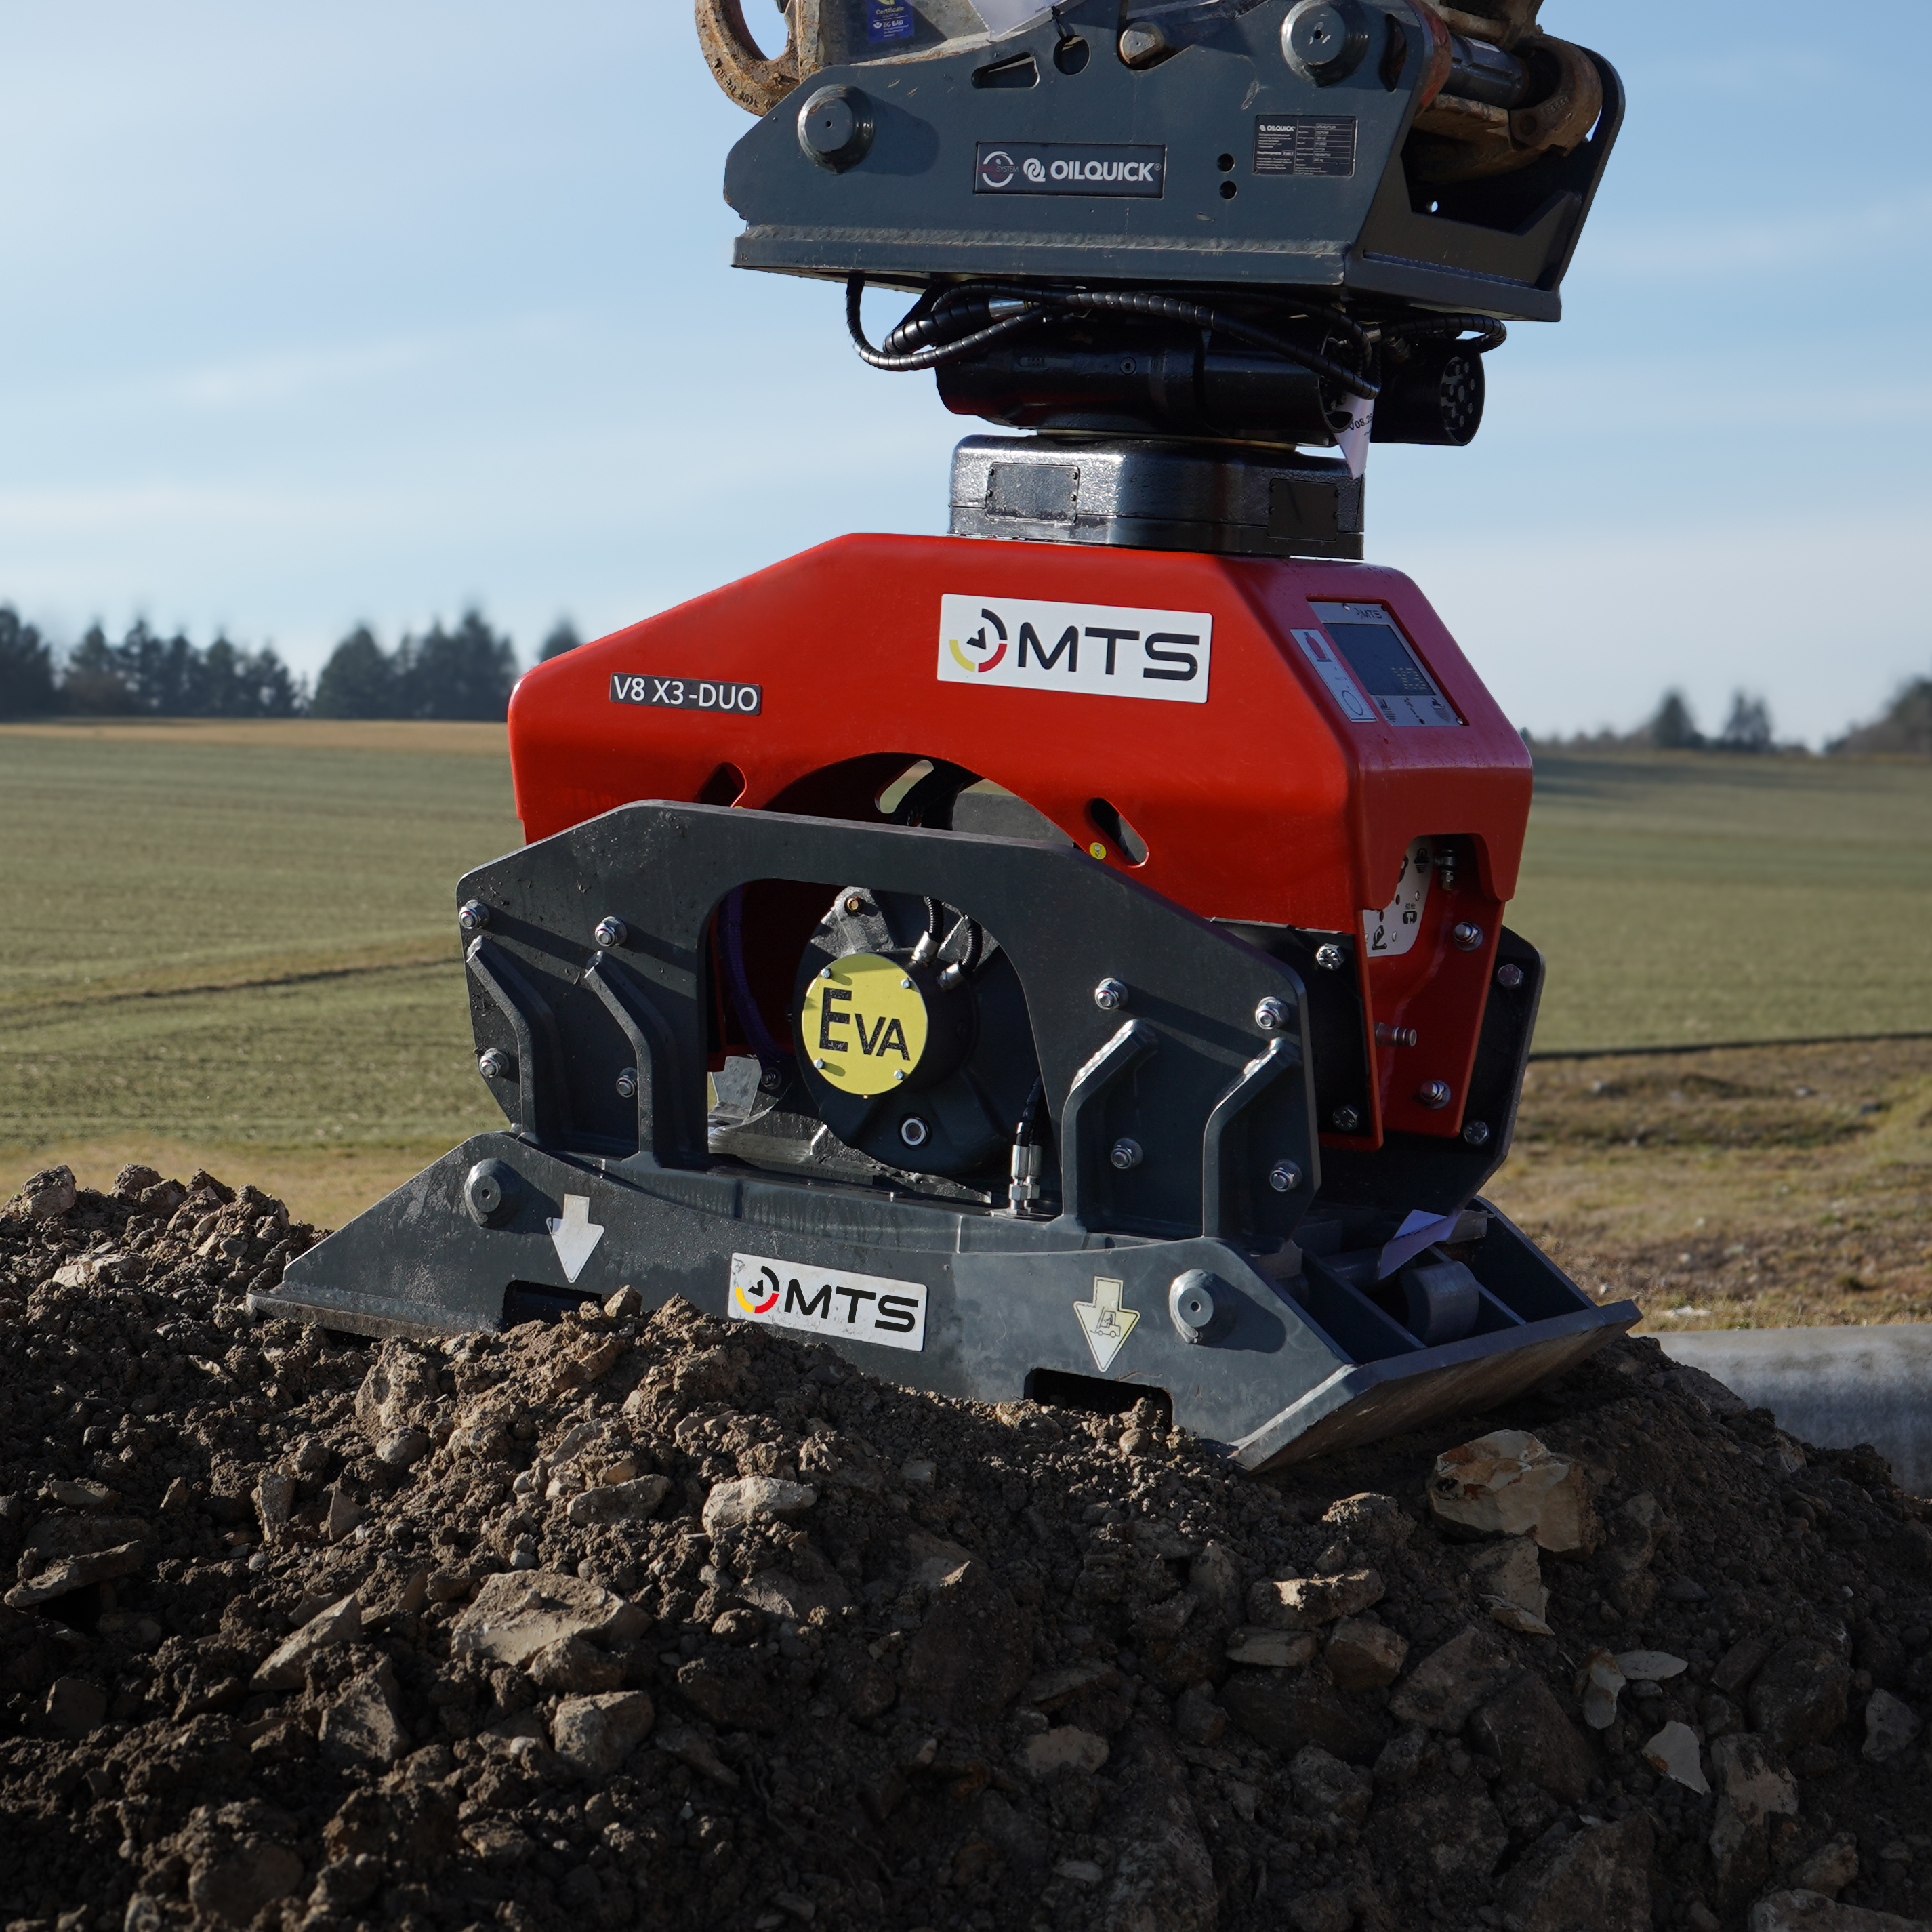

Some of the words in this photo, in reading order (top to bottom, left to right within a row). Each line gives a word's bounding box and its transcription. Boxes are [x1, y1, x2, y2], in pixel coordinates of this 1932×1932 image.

[1050, 160, 1155, 182] OILQUICK
[1359, 609, 1382, 618] MTS
[1018, 621, 1200, 682] MTS
[613, 676, 645, 701] V8
[784, 1278, 919, 1333] MTS
